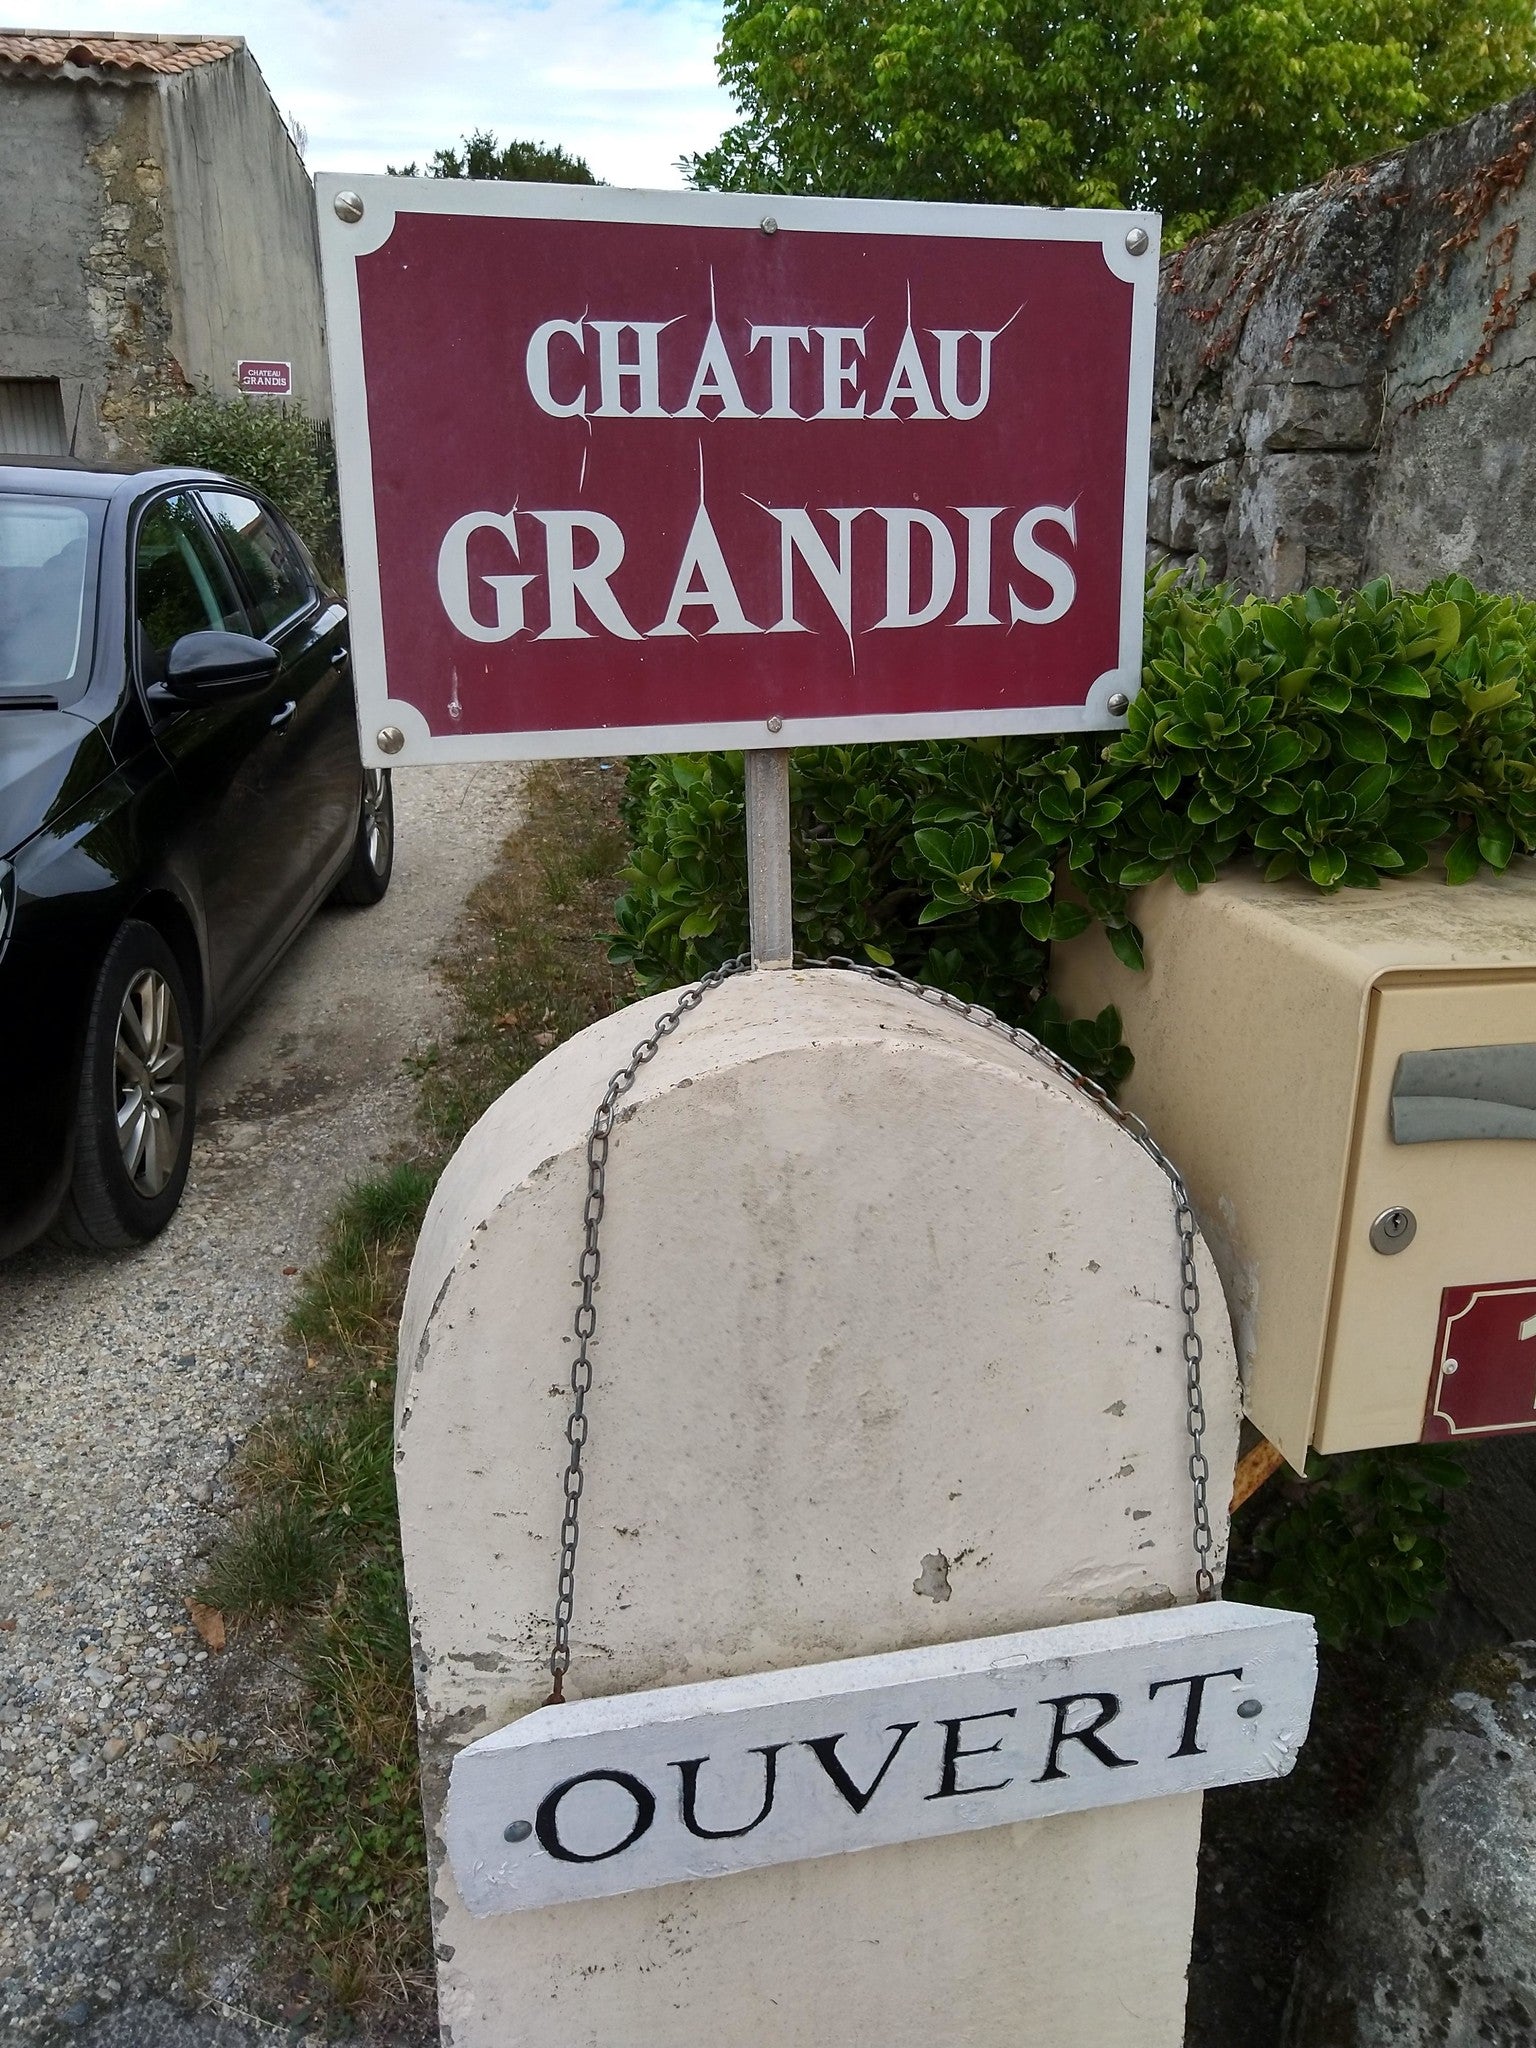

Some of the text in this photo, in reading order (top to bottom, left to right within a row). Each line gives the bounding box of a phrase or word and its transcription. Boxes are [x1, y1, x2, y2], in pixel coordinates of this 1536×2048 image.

[243, 377, 287, 386] GRANDIS
[525, 280, 1020, 426] CHATEAU
[437, 450, 1081, 664] GRANDIS
[535, 1668, 1243, 1863] OUVERT
